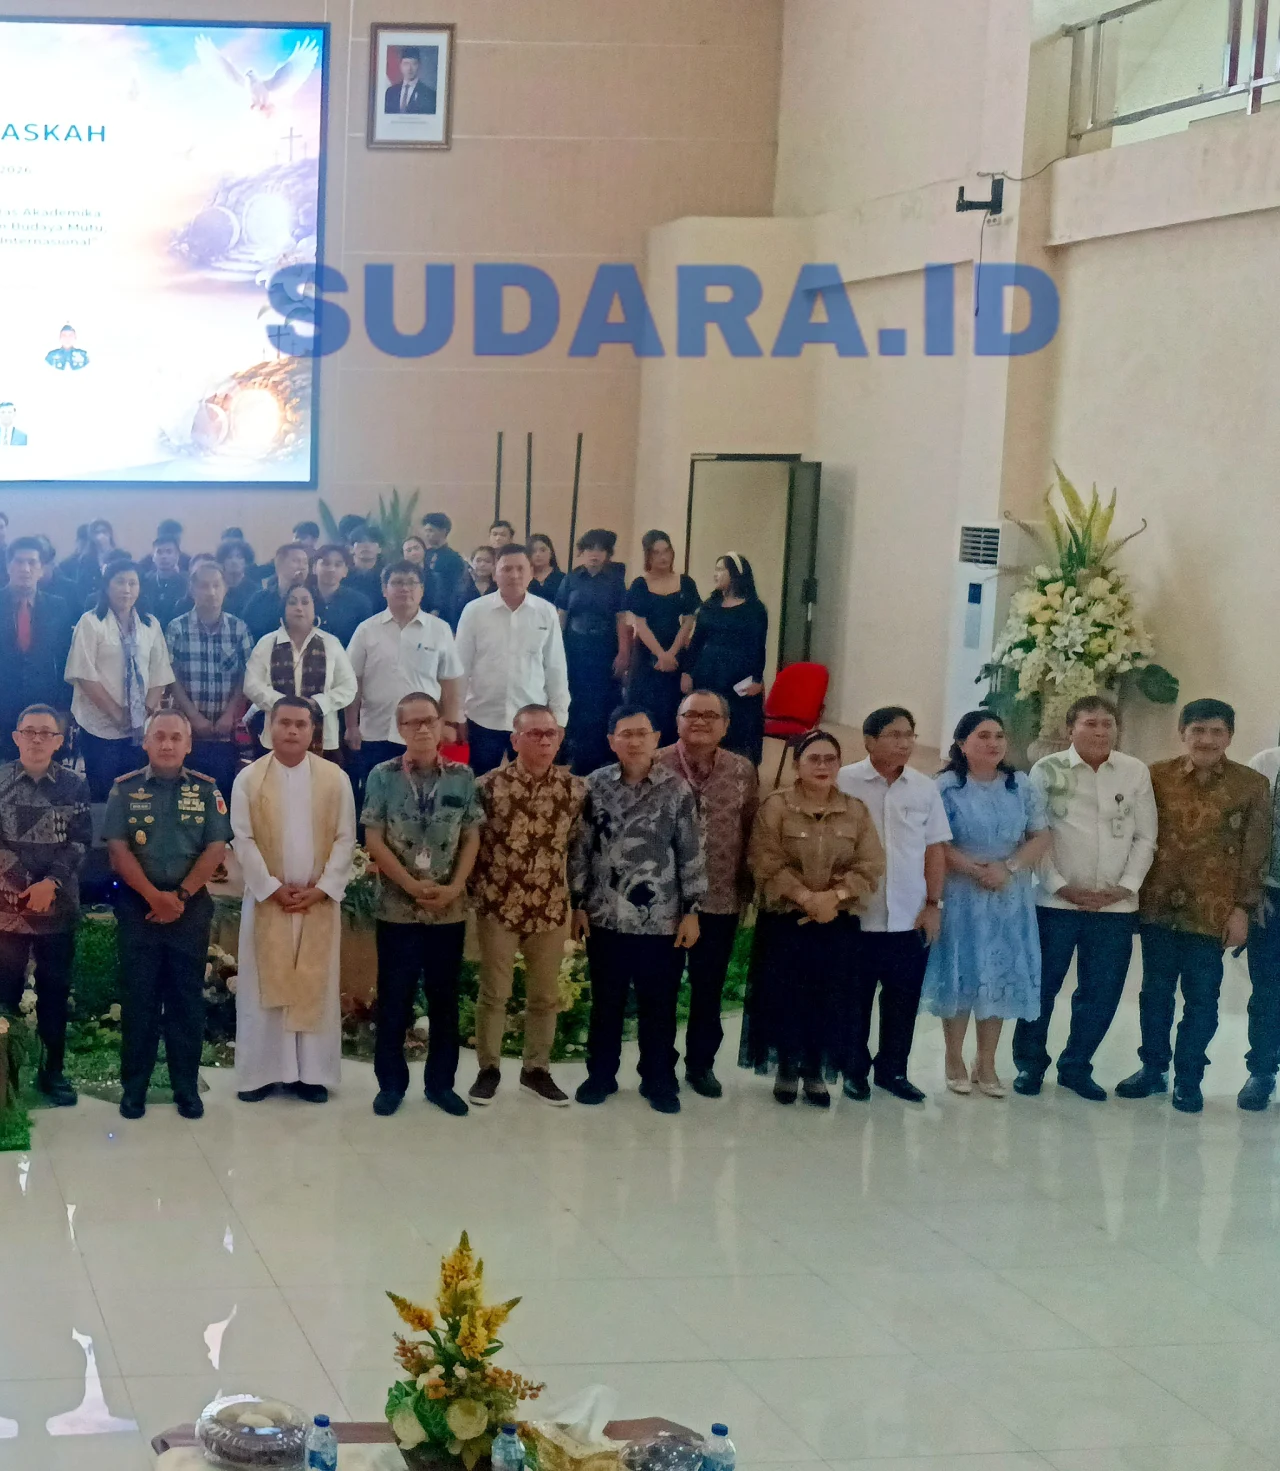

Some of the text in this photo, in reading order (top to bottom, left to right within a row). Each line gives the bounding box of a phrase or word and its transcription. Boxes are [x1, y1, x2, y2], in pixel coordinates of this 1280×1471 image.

[0, 165, 33, 174] 2026
[22, 207, 102, 218] Akademika
[10, 221, 63, 233] Budaya
